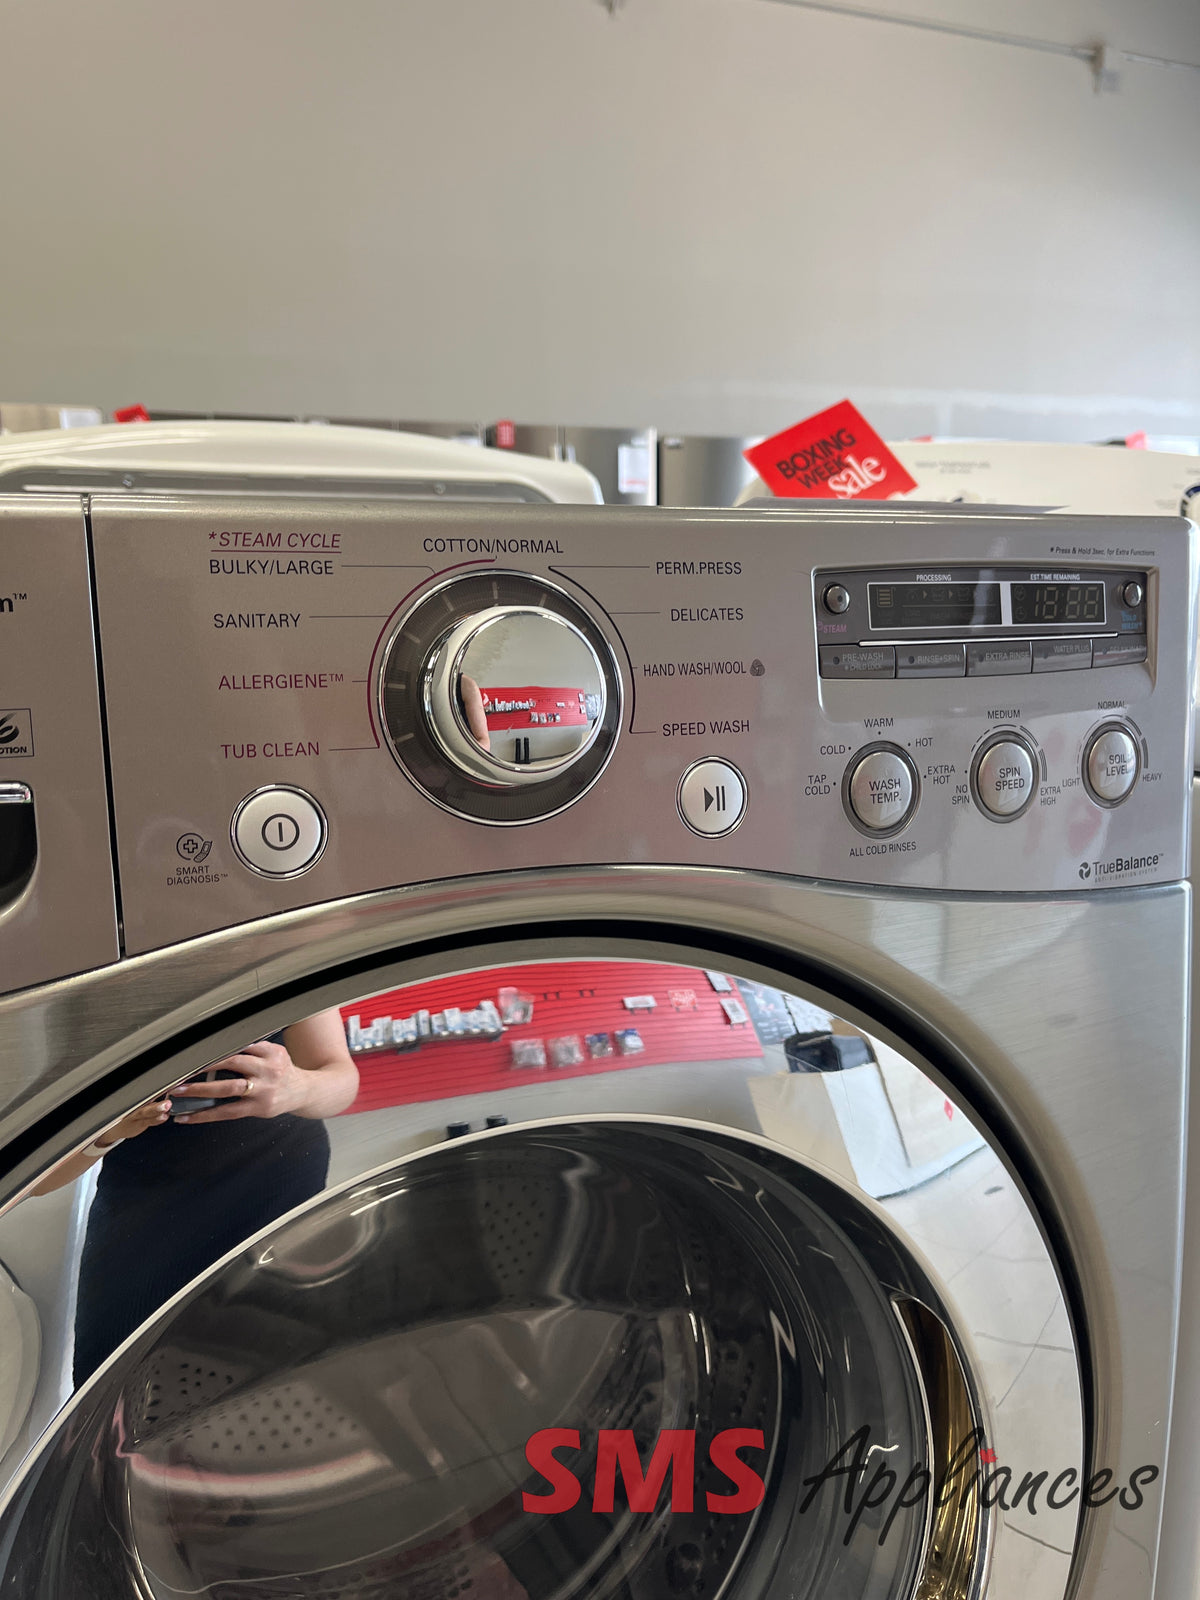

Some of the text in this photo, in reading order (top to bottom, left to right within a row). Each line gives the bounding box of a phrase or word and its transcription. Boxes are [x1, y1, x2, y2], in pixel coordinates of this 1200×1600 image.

[776, 428, 856, 480] BOXING
[797, 454, 848, 489] WEEK
[828, 454, 887, 499] sale
[287, 533, 341, 548] CYCLE
[423, 538, 564, 554] COTTON/NORMAL
[209, 559, 334, 576] BULKY/LARGE
[656, 561, 742, 576] PERM.PRESS
[916, 574, 952, 582] PROCESSING
[1052, 573, 1080, 581] REMAINING
[670, 607, 744, 622] DELICATES
[213, 614, 301, 629] SANITARY
[823, 624, 847, 634] STEAM
[842, 652, 884, 662] PRE-WASH
[985, 652, 1030, 661] EXTRA RINSE
[643, 662, 747, 677] HAND WASH/WOOL
[218, 674, 344, 691] ALLERGIENE™
[1097, 701, 1126, 710] NORMAL
[987, 710, 1020, 719] MEDIUM
[662, 720, 750, 737] SPEED WASH
[863, 718, 894, 728] WARM
[915, 737, 933, 748] HOT
[221, 742, 320, 759] TUB CLEAN
[820, 745, 846, 755] COLD
[1108, 754, 1127, 765] SOIL
[927, 765, 956, 775] EXTRA
[999, 767, 1021, 779] SPIN
[1106, 765, 1129, 777] LEVEL
[808, 775, 827, 785] TAP
[932, 775, 950, 785] HOT
[1062, 778, 1080, 788] LIGHT
[1142, 773, 1162, 782] HEAVY
[869, 778, 901, 791] WASH
[955, 785, 968, 794] NO
[995, 779, 1025, 791] SPEED
[804, 785, 831, 796] COLD
[1040, 786, 1061, 796] EXTRA
[870, 792, 902, 805] TEMP.
[952, 795, 970, 805] SPIN
[1040, 797, 1056, 806] HIGH
[849, 841, 917, 857] ALL COLD RINSES
[175, 865, 209, 876] SMART
[166, 873, 228, 886] DIAGNOSIS™
